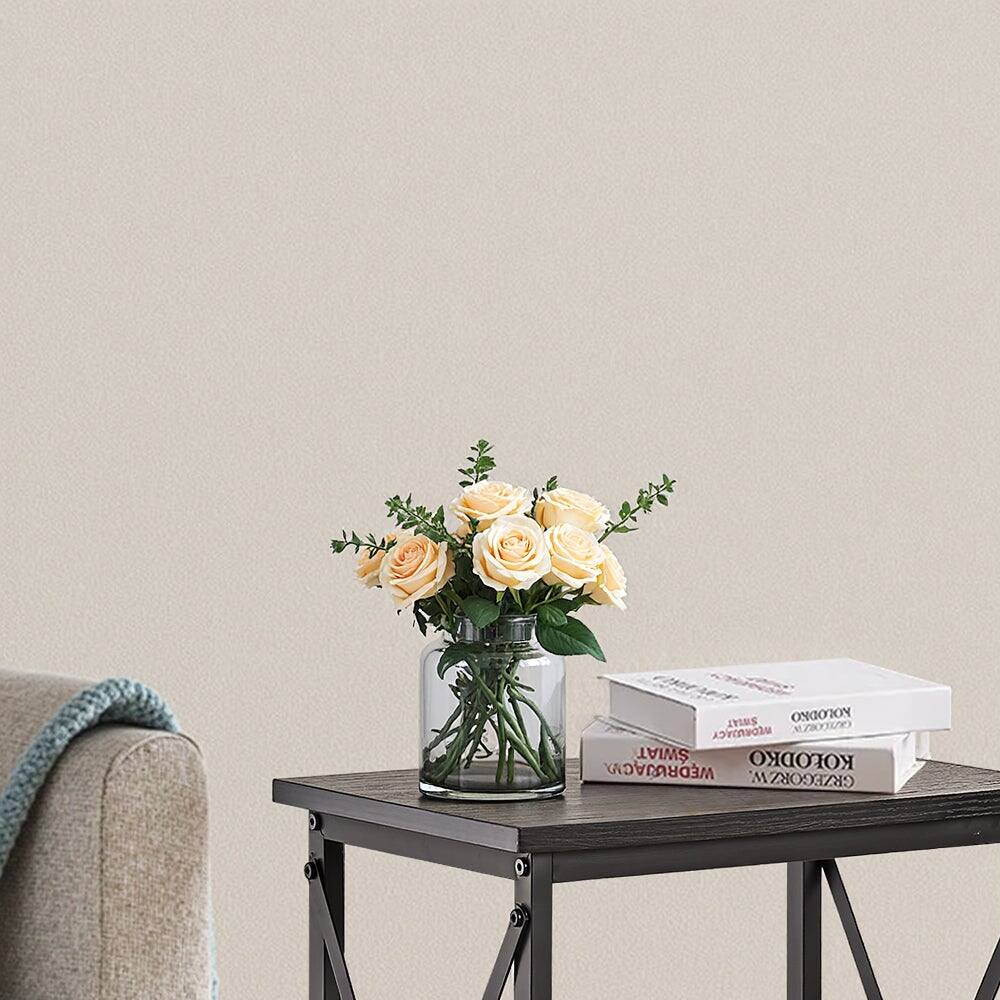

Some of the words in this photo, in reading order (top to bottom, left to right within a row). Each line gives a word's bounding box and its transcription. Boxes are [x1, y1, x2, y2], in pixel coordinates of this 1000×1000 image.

[637, 747, 690, 765] ŚWIAT
[749, 749, 854, 770] KOŁODKO
[770, 771, 855, 788] GRZEGORZ
